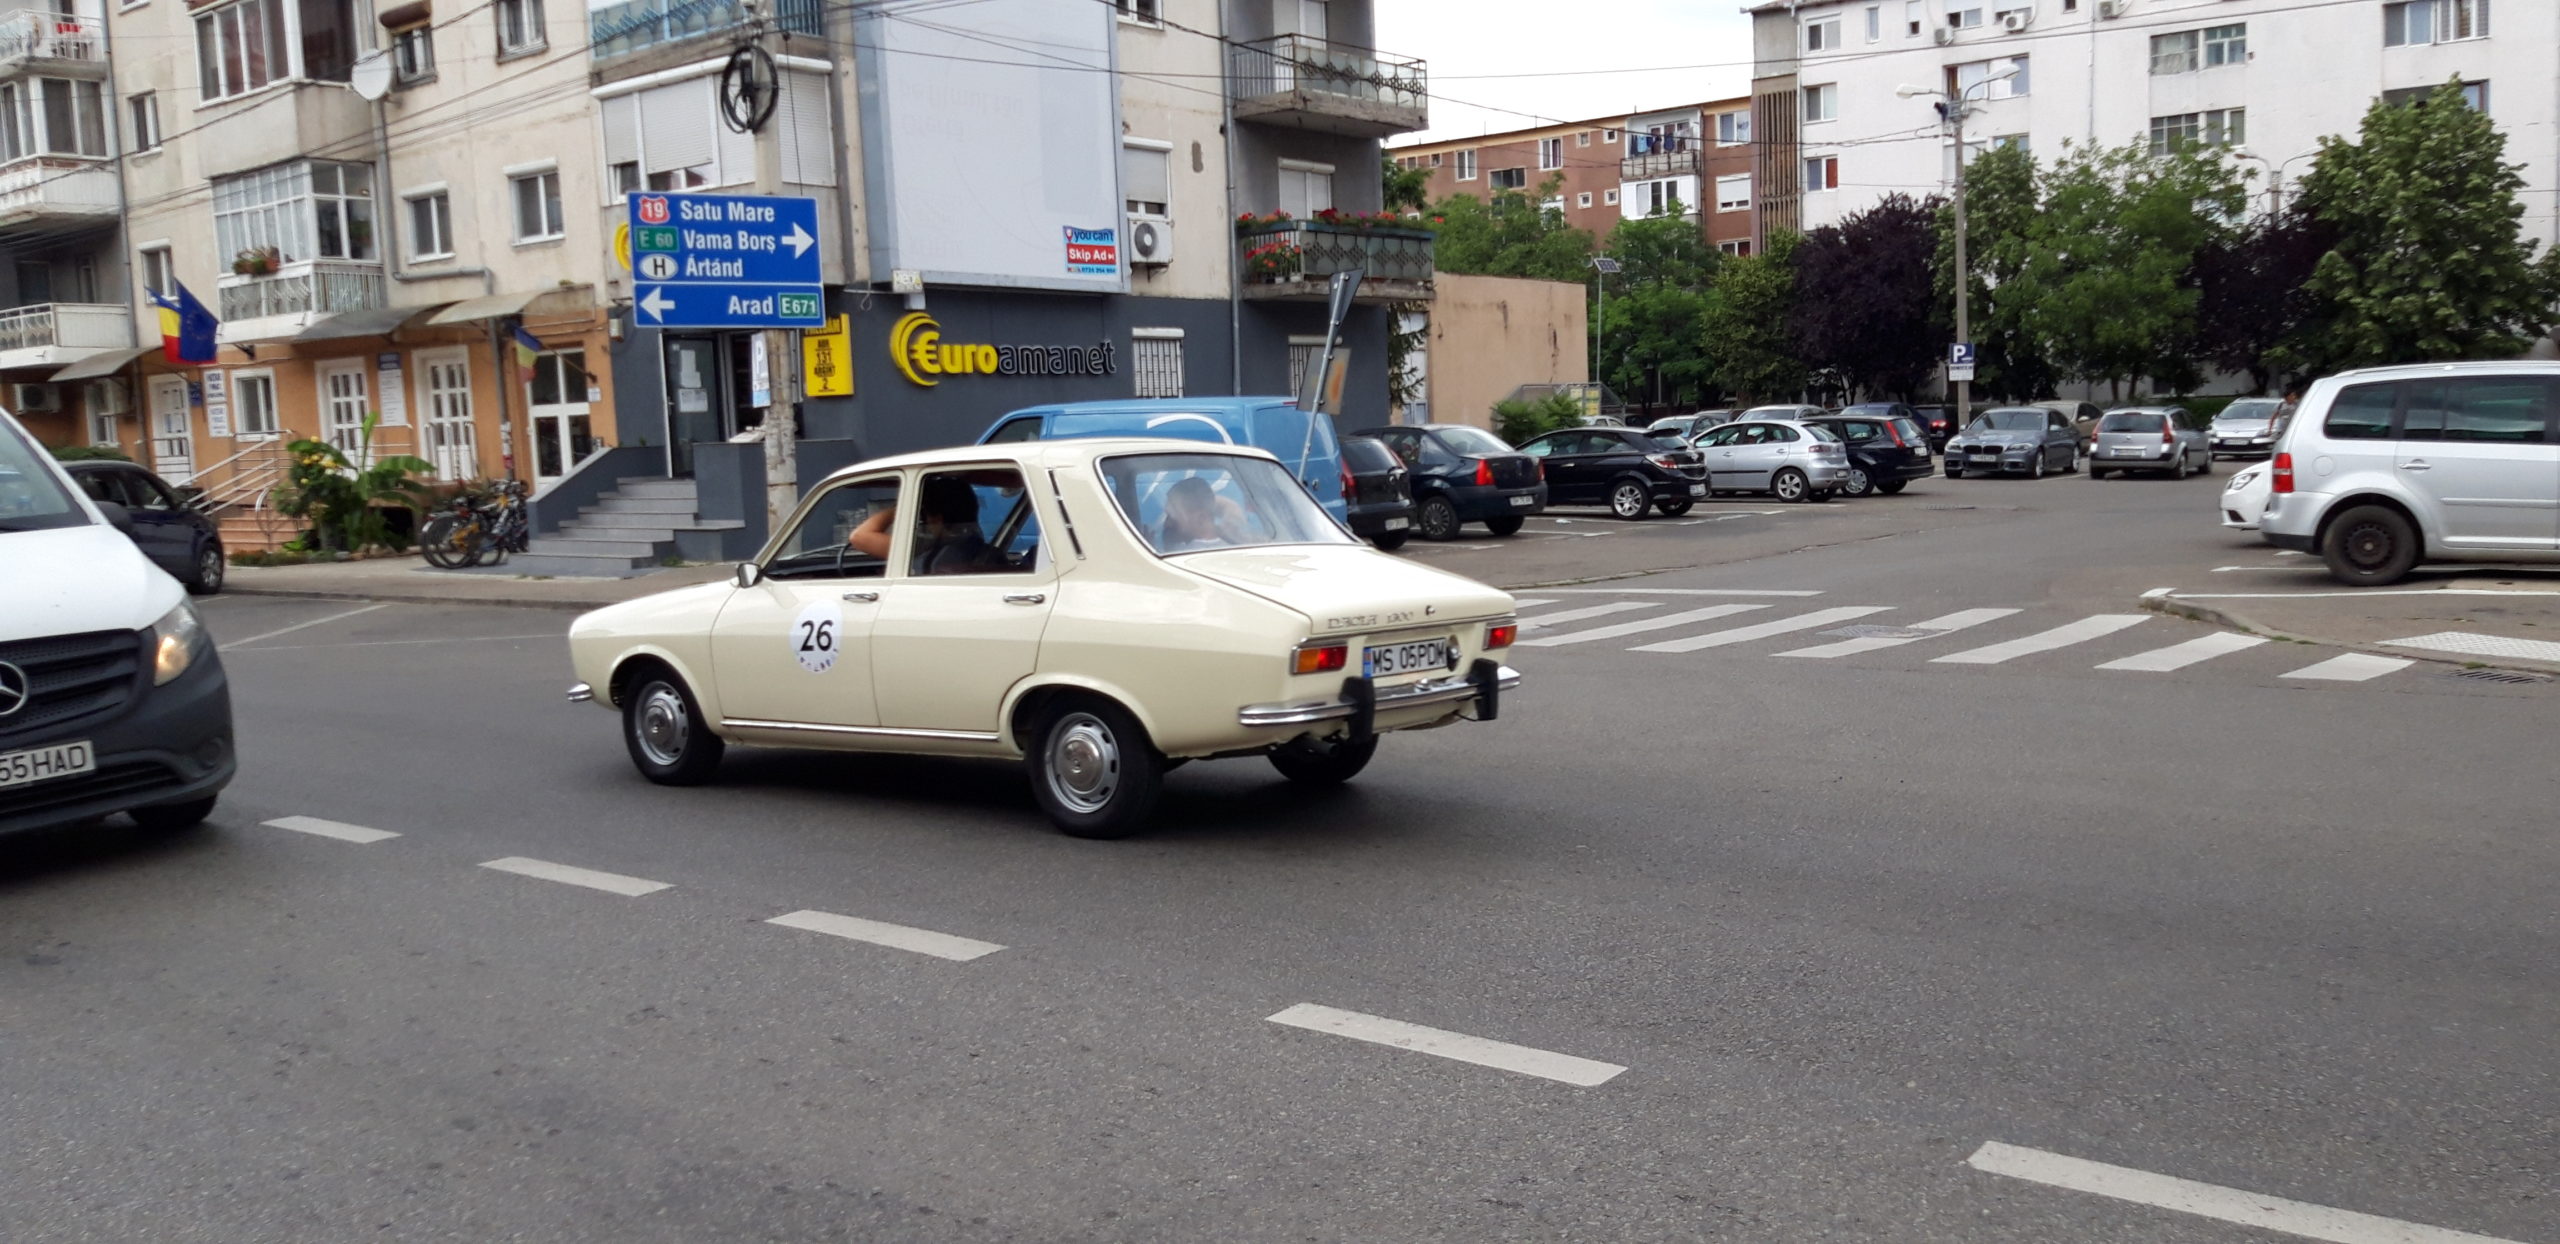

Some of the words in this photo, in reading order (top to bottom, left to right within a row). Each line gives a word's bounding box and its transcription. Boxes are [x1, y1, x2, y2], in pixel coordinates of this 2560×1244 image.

[644, 202, 664, 218] 19
[680, 200, 722, 221] Satu
[728, 202, 776, 222] Mare
[639, 230, 650, 247] E
[655, 233, 674, 247] 60
[683, 229, 733, 249] Vama
[737, 230, 777, 254] Borș
[1074, 231, 1091, 243] you
[653, 257, 667, 276] H
[685, 254, 744, 277] Ártánd
[1069, 248, 1091, 262] Skip
[1093, 249, 1107, 260] Ad
[728, 295, 774, 315] Arad
[781, 297, 817, 315] E671
[1953, 345, 1967, 363] P
[800, 620, 833, 651] 26
[1372, 648, 1394, 673] MS
